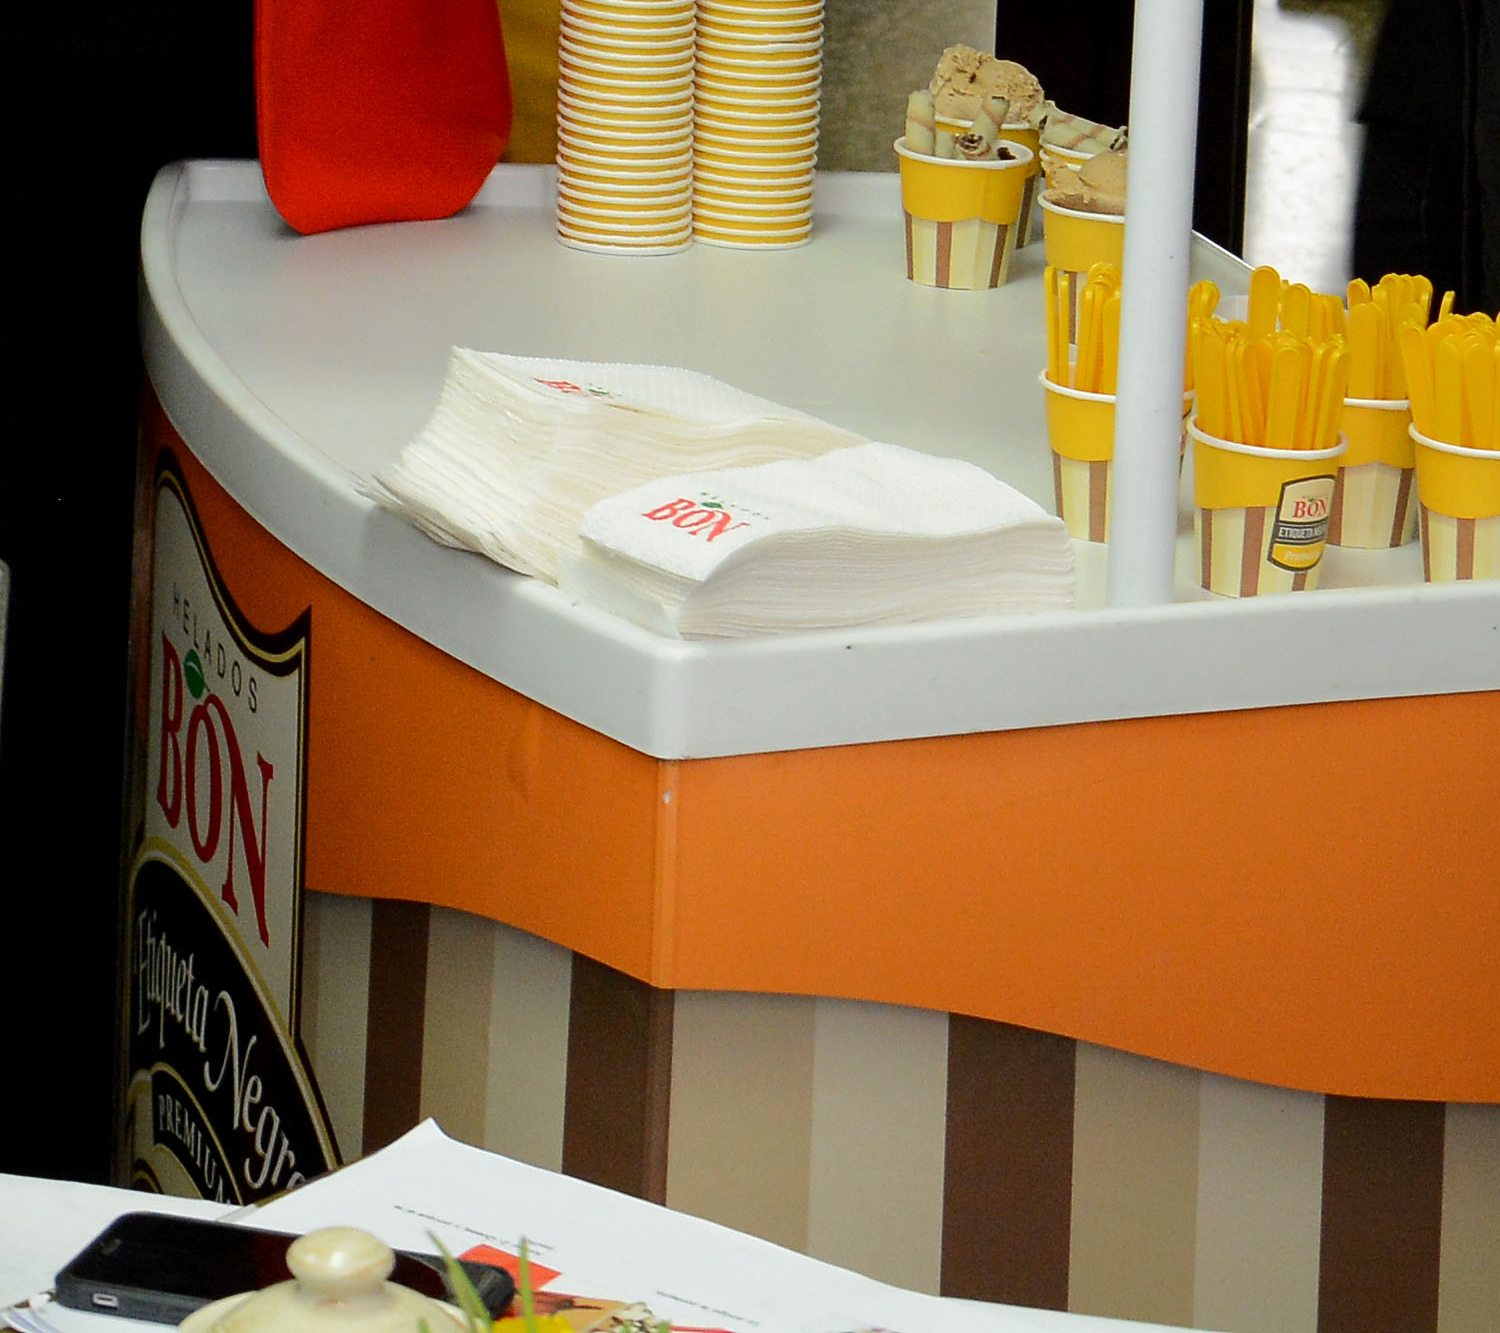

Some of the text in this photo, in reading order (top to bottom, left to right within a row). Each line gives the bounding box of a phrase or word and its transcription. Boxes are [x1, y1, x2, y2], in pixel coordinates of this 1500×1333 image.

[642, 497, 750, 542] BON
[173, 582, 258, 714] HELADOS
[156, 629, 274, 949] BON
[136, 908, 208, 1050] Etiqueta
